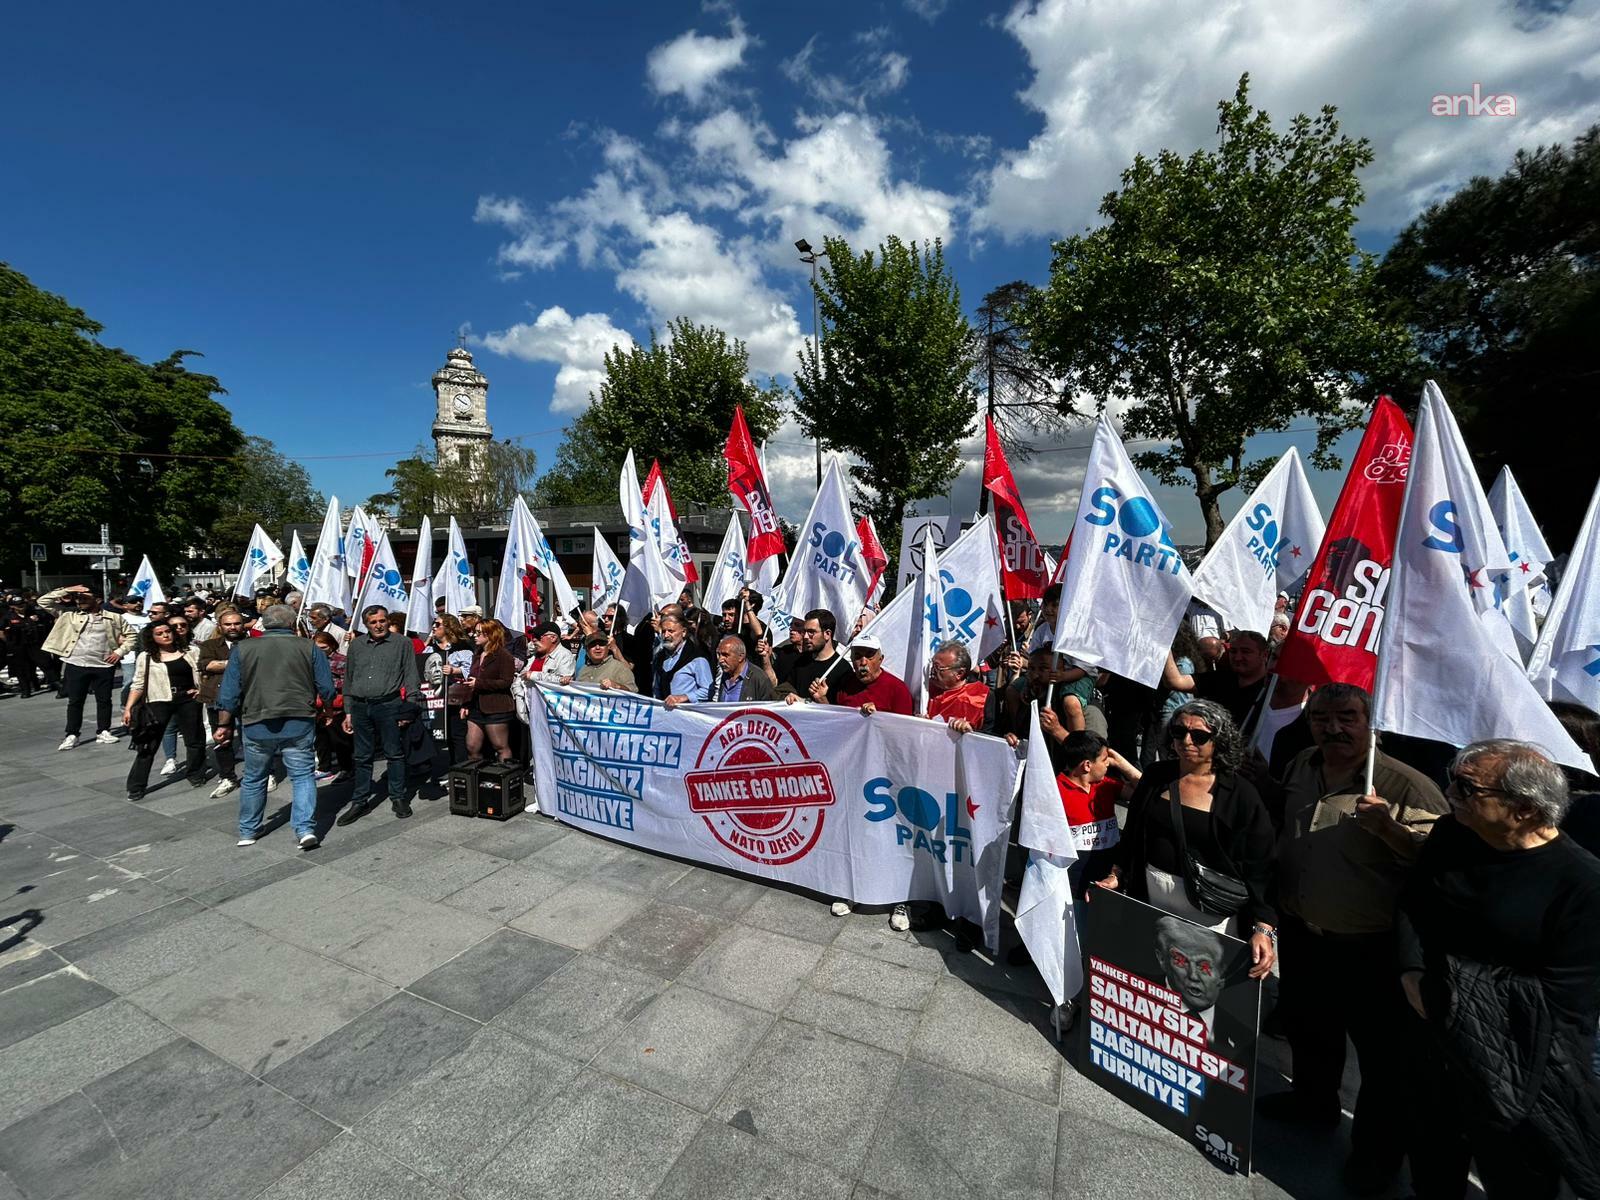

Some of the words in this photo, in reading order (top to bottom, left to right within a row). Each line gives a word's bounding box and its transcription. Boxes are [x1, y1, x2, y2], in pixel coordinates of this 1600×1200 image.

[808, 521, 857, 571] SOL
[1298, 589, 1384, 655] Gen
[550, 724, 680, 766] SATANATSIZ
[747, 720, 783, 746] DEFOL
[694, 779, 750, 802] YANKEE
[750, 777, 774, 800] GO
[775, 774, 828, 799] HOME
[863, 777, 972, 840] SOL
[729, 829, 765, 854] NATO
[768, 828, 805, 855] DEFOL
[1090, 959, 1128, 984] YANKEE
[1130, 978, 1145, 991] GO
[1149, 986, 1180, 1007] HOME
[1091, 975, 1204, 1044] SARAYSIZ
[1090, 999, 1245, 1091] SALTANATSIZ
[1090, 1020, 1202, 1096] BAĞIMSIZ
[1195, 1125, 1239, 1161] SOL
